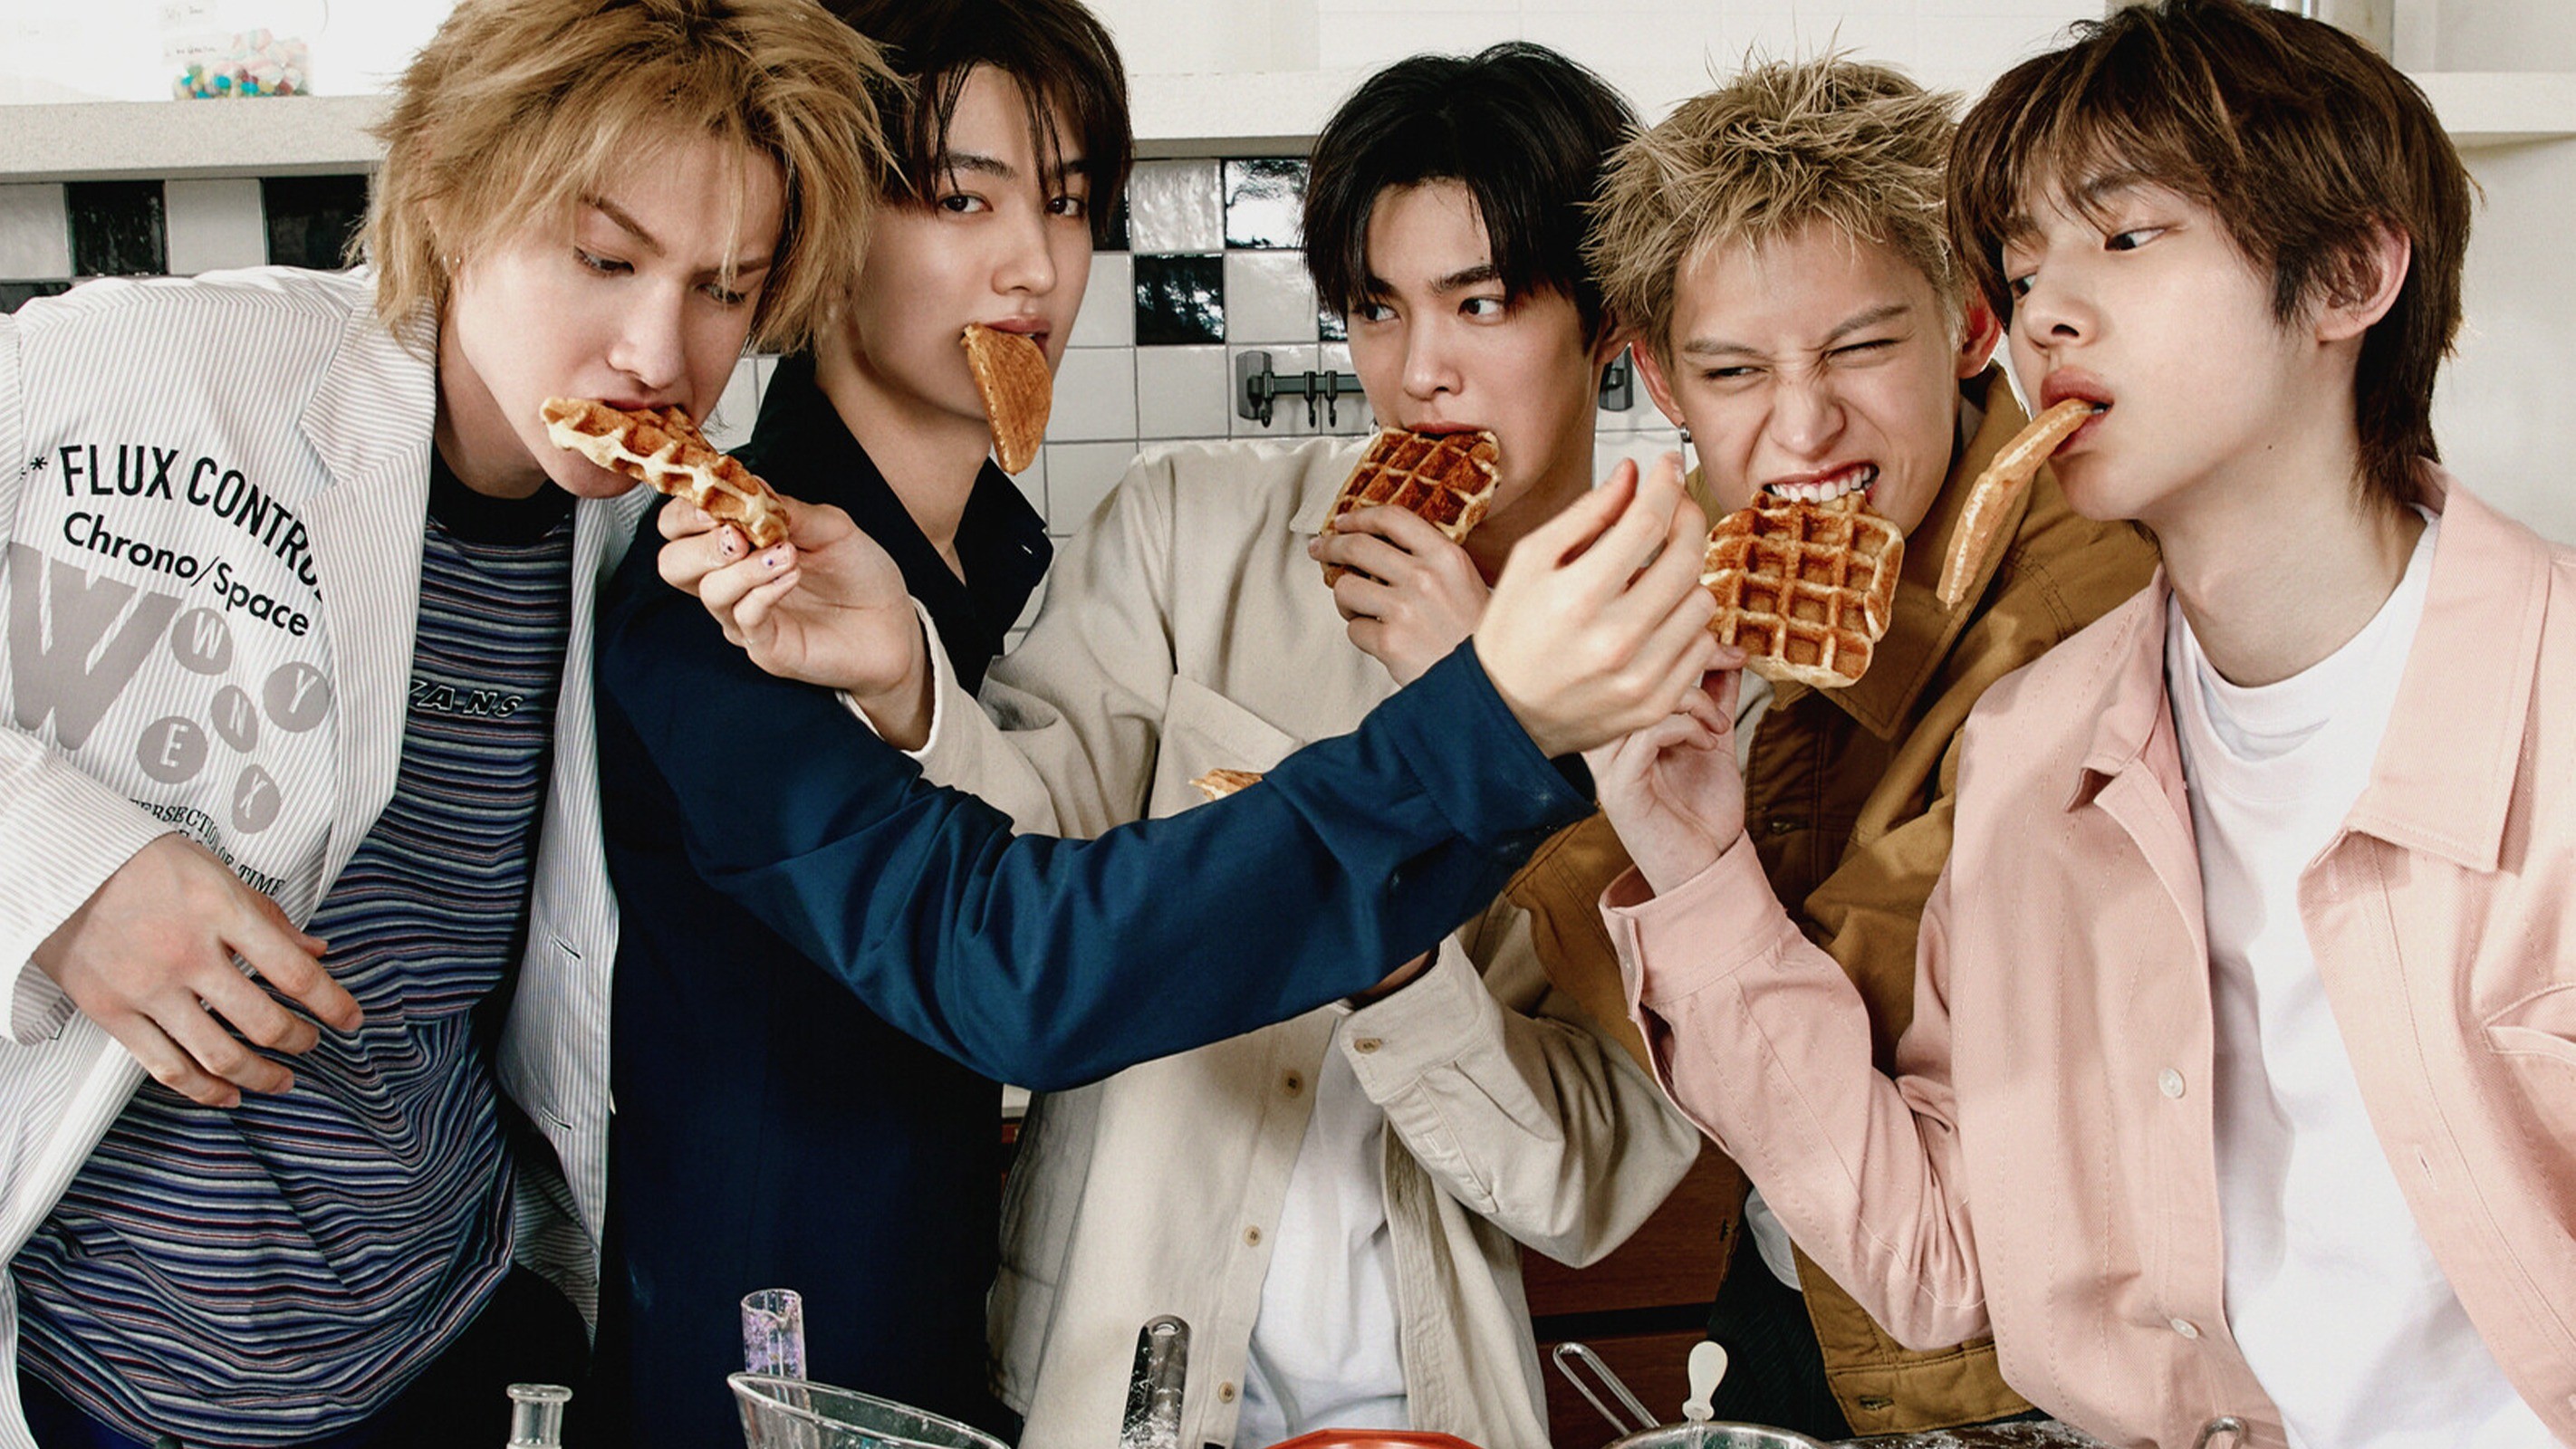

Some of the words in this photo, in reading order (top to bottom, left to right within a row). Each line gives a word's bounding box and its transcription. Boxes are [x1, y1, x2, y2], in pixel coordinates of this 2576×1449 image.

[59, 444, 179, 500] FLUX
[187, 456, 323, 604] CONTRO
[62, 511, 310, 637] Chrono/Space
[191, 610, 226, 661] W
[288, 667, 319, 715] Y
[159, 723, 189, 768] E
[238, 772, 268, 820] X
